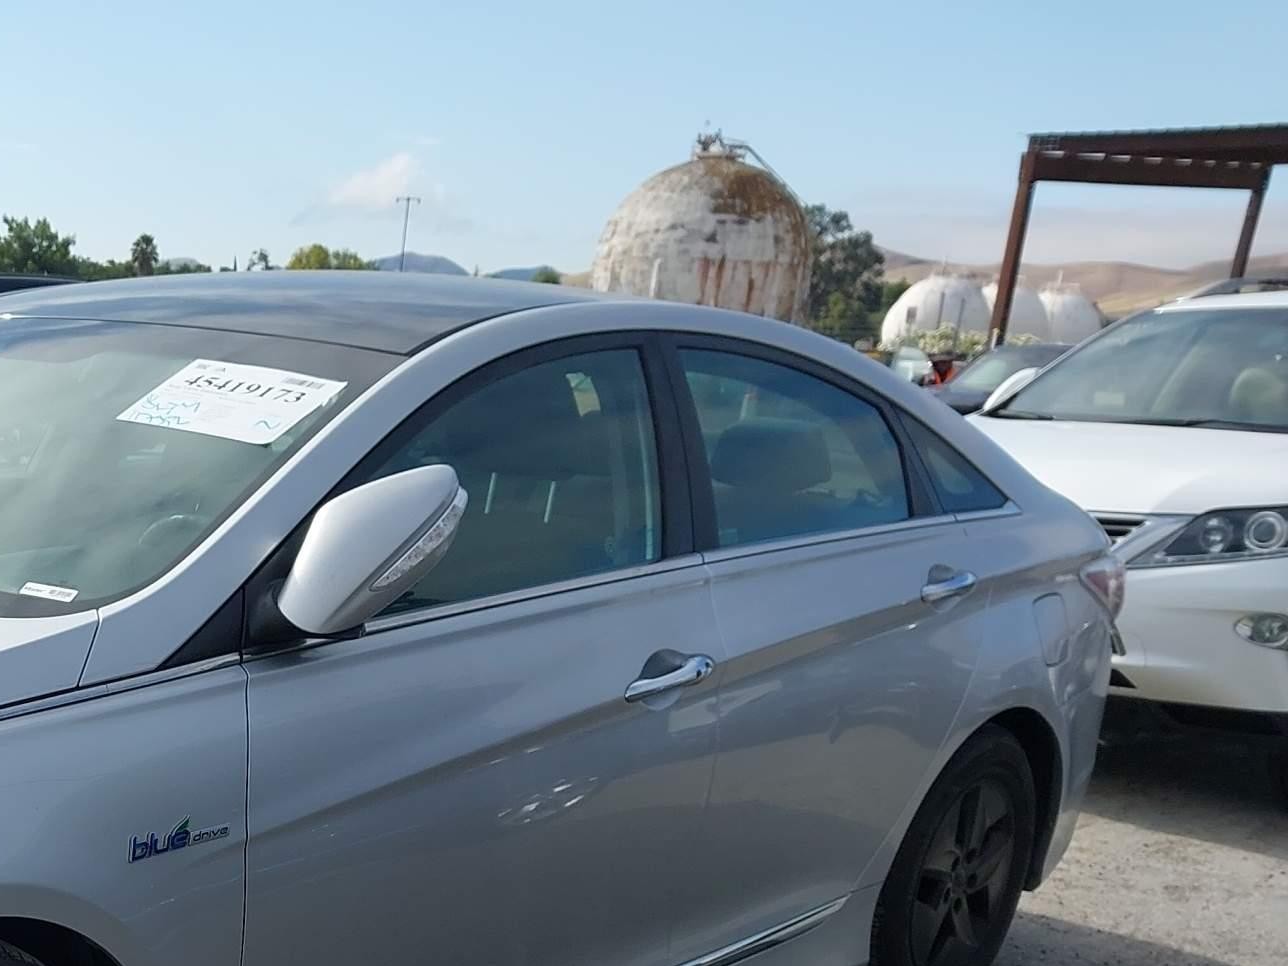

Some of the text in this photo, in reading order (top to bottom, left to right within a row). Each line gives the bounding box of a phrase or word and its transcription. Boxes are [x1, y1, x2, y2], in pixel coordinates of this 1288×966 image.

[184, 374, 307, 403] 45419173
[128, 823, 230, 863] blue drive
